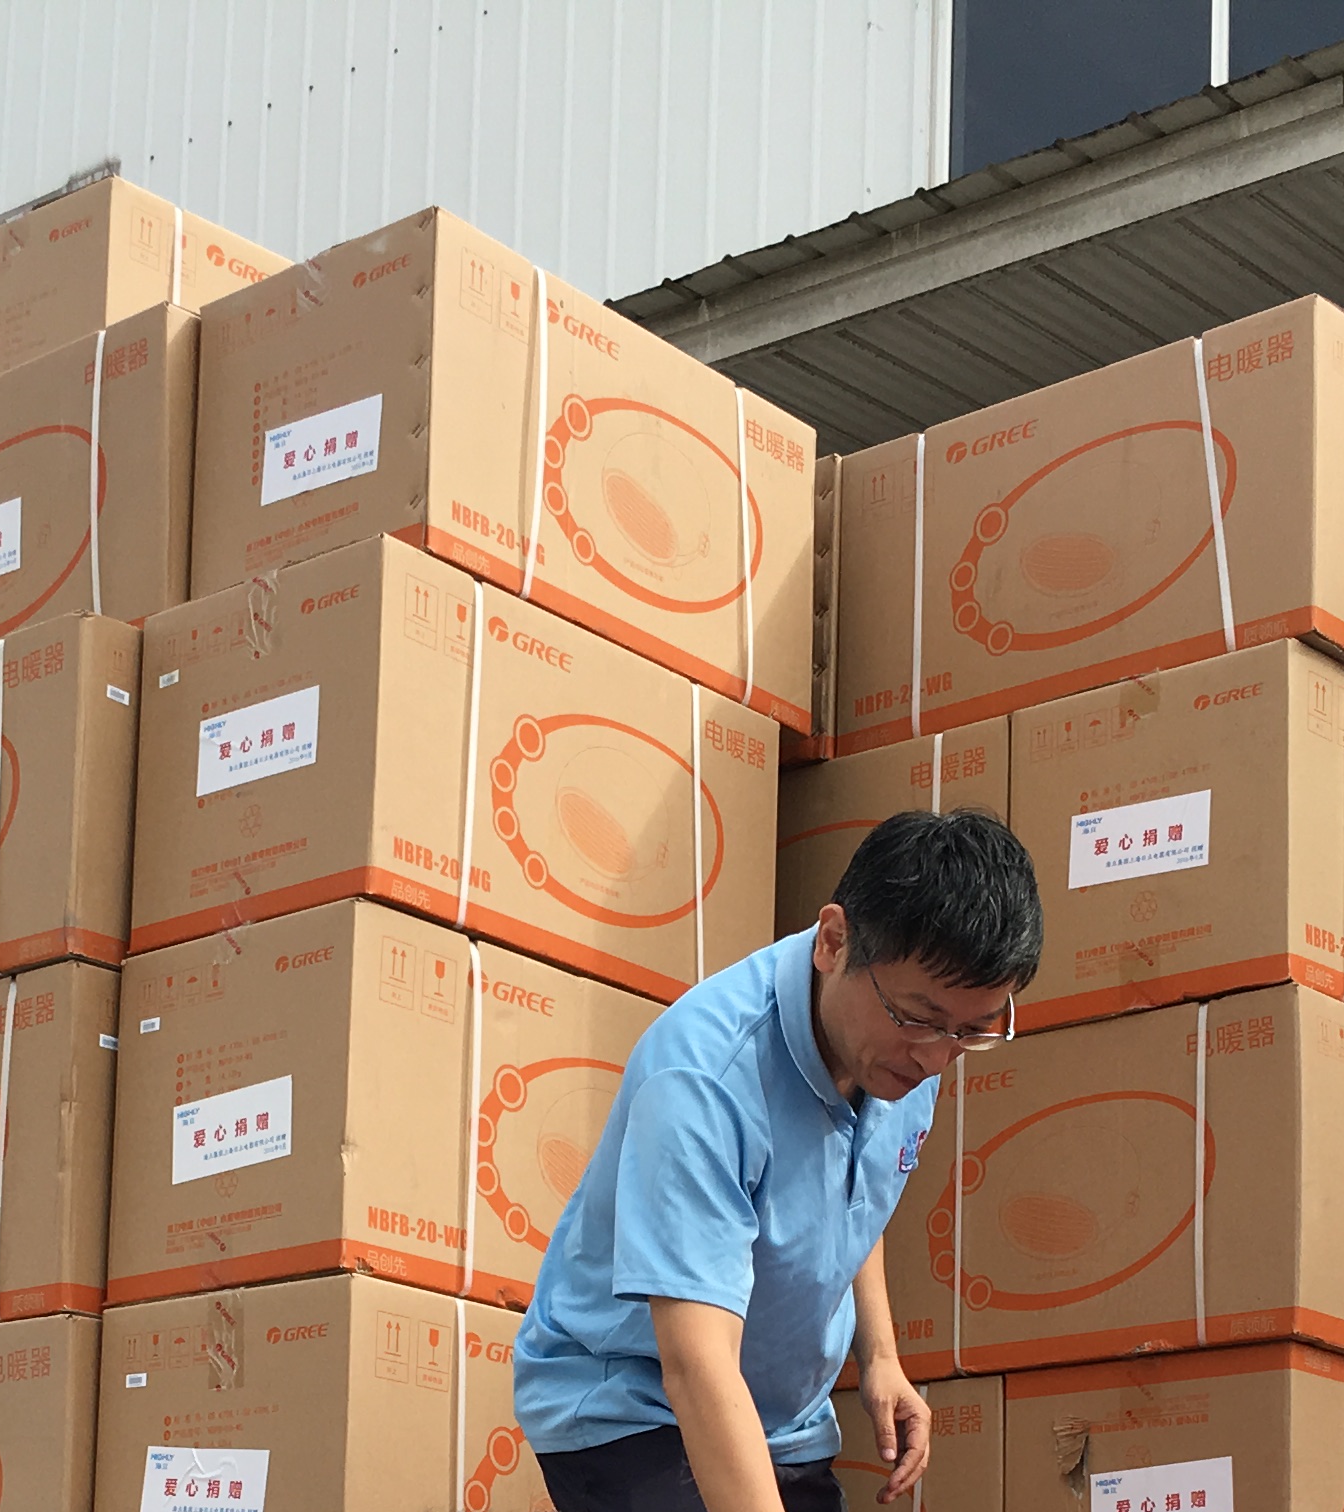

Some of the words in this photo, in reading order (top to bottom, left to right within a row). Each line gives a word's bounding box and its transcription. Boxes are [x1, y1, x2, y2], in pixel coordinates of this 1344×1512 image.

[368, 252, 413, 282] GREE
[563, 318, 621, 361] GREE
[1206, 330, 1294, 382] 电暖器
[282, 430, 359, 470] 爱心捐赠
[745, 418, 805, 474] 电暖器
[971, 418, 1039, 456] GREE
[317, 584, 360, 611] GREE
[512, 635, 573, 673] GREE
[1213, 683, 1264, 706] GREE
[219, 722, 297, 761] 爱心捐赠
[705, 719, 766, 771] 电暖器
[1094, 824, 1184, 856] 爱心捐赠
[391, 880, 431, 910] 品创先
[292, 946, 334, 971] GREE
[493, 981, 555, 1017] GREE
[193, 1112, 270, 1149] 爱心捐赠
[366, 1250, 407, 1277] 品创先
[284, 1323, 329, 1343] GREE
[163, 1478, 242, 1500] 爱心捐赠
